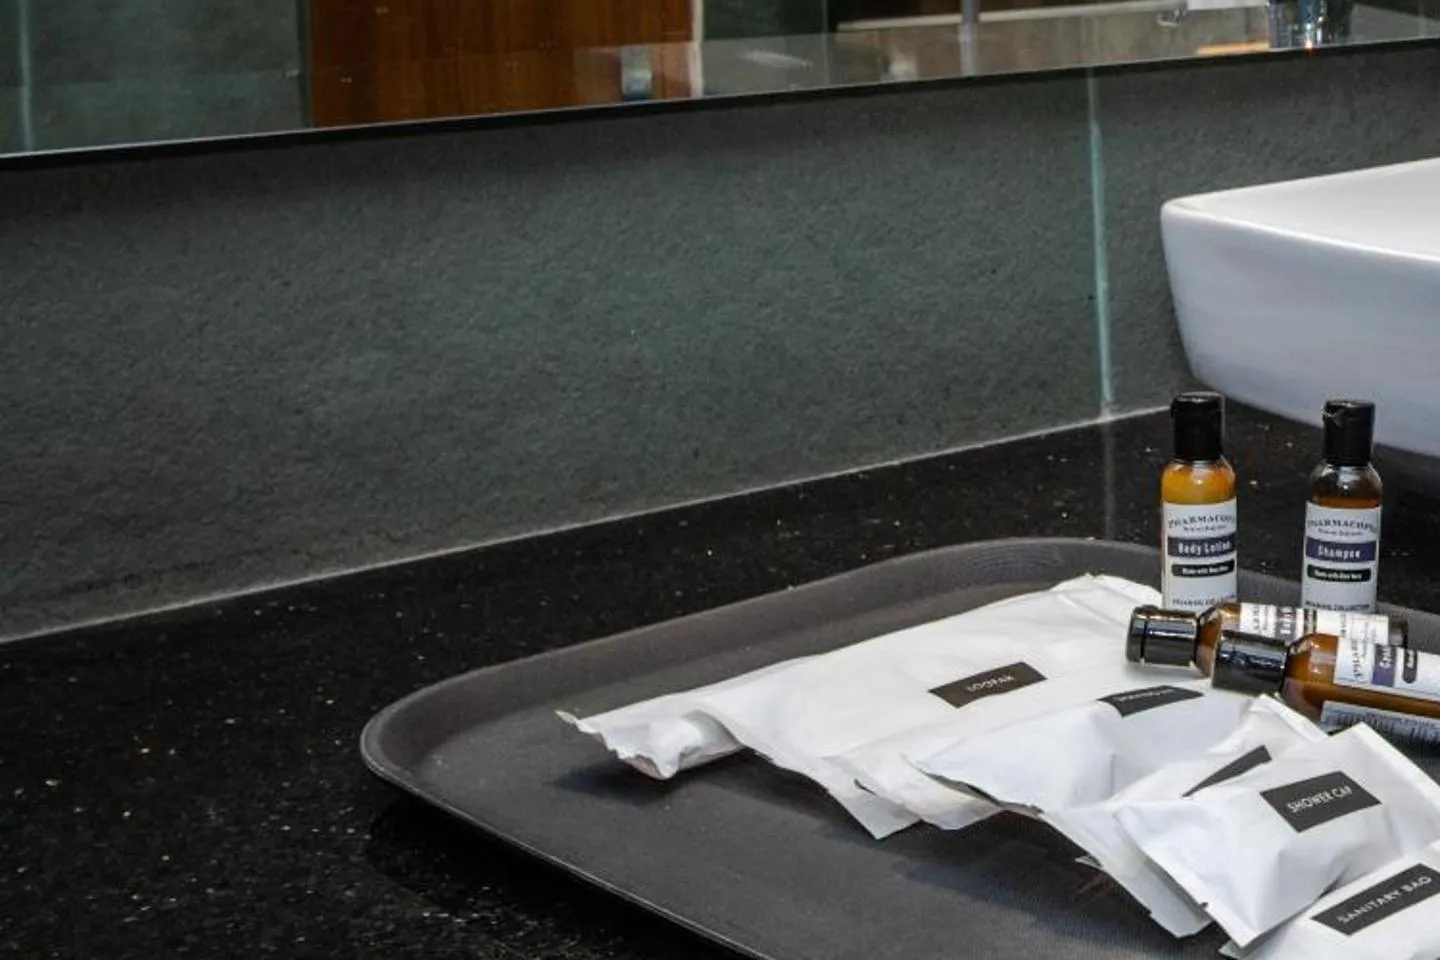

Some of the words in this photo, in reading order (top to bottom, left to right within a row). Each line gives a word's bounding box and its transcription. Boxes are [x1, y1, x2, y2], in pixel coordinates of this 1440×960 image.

[1178, 542, 1202, 556] Body
[1317, 544, 1361, 560] Shampoo
[1286, 791, 1334, 813] SHOWER
[1336, 890, 1402, 923] SANITARY
[1401, 876, 1432, 892] BAG
